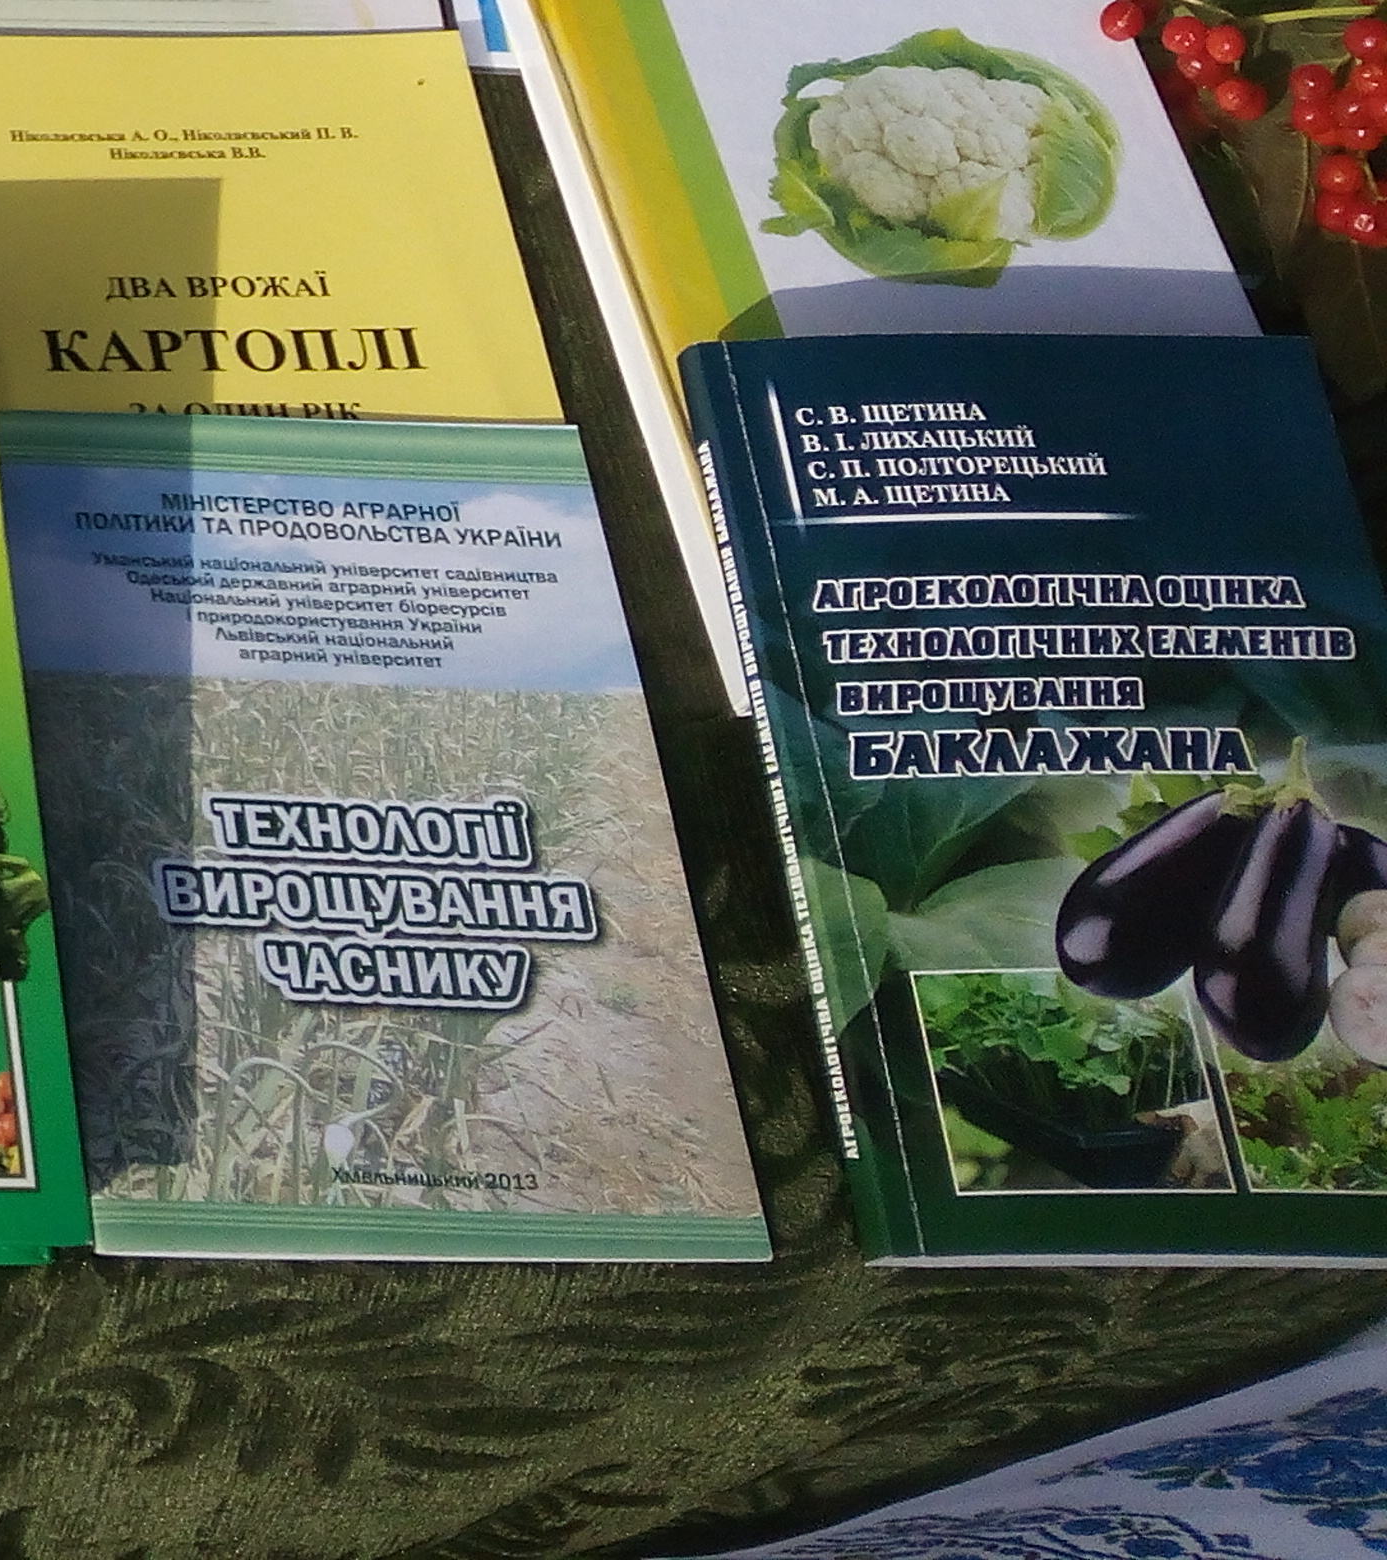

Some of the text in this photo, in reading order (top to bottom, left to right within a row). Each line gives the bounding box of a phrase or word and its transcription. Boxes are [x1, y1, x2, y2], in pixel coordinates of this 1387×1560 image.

[106, 270, 331, 302] ДВА ВРОЖАЇ
[45, 326, 429, 373] КАРТОПЛІ
[861, 401, 987, 425] ЩЕТИНА
[860, 425, 1037, 452] ЛИХАЦЬКИЙ
[876, 452, 1108, 480] ПОЛТОРЕЦЬКИЙ
[161, 492, 461, 523] МІНІСТЕРСТВО АГРАРНОЇ
[885, 482, 1011, 507] ЩЕТИНА
[74, 510, 563, 550] ПОЛІТИКИ ТА ПРОДОВОЛЬСТВА УКРАЇНИ
[813, 574, 1306, 613] АГРОЕКОЛОГІЧНА ОЦІНКА
[823, 625, 1356, 663] ТЕХНОЛОГІЧНИХ ЕЛЕМЕНТІВ
[836, 676, 1145, 716] ВИРОЩУВАННЯ
[849, 726, 1258, 781] БАКЛАЖАНА
[208, 796, 528, 864] ТЕХНОЛОГІЇ
[160, 863, 595, 937] ВИРОЩУВАННЯ
[261, 938, 527, 1003] ЧАСНИКУ
[484, 1171, 539, 1191] 2013
